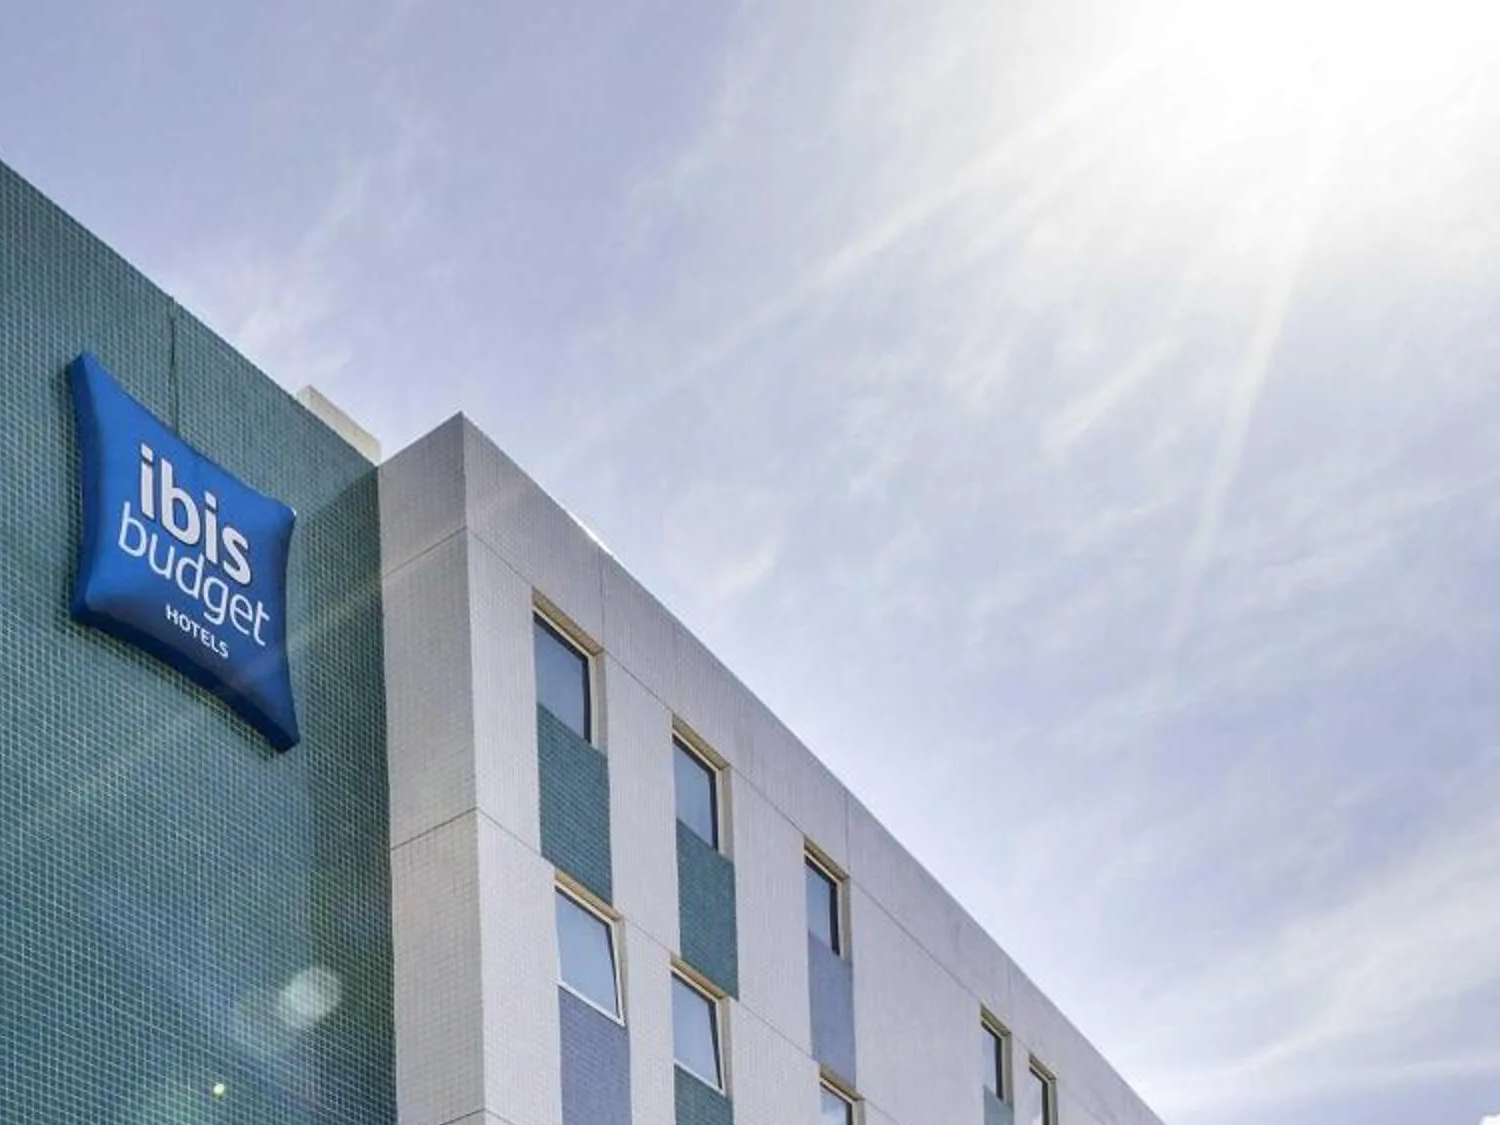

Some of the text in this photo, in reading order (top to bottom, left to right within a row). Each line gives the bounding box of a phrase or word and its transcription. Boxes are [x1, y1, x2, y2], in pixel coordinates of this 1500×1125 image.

[118, 501, 270, 646] budget
[141, 442, 251, 585] ibis
[165, 603, 229, 658] HOTELS
